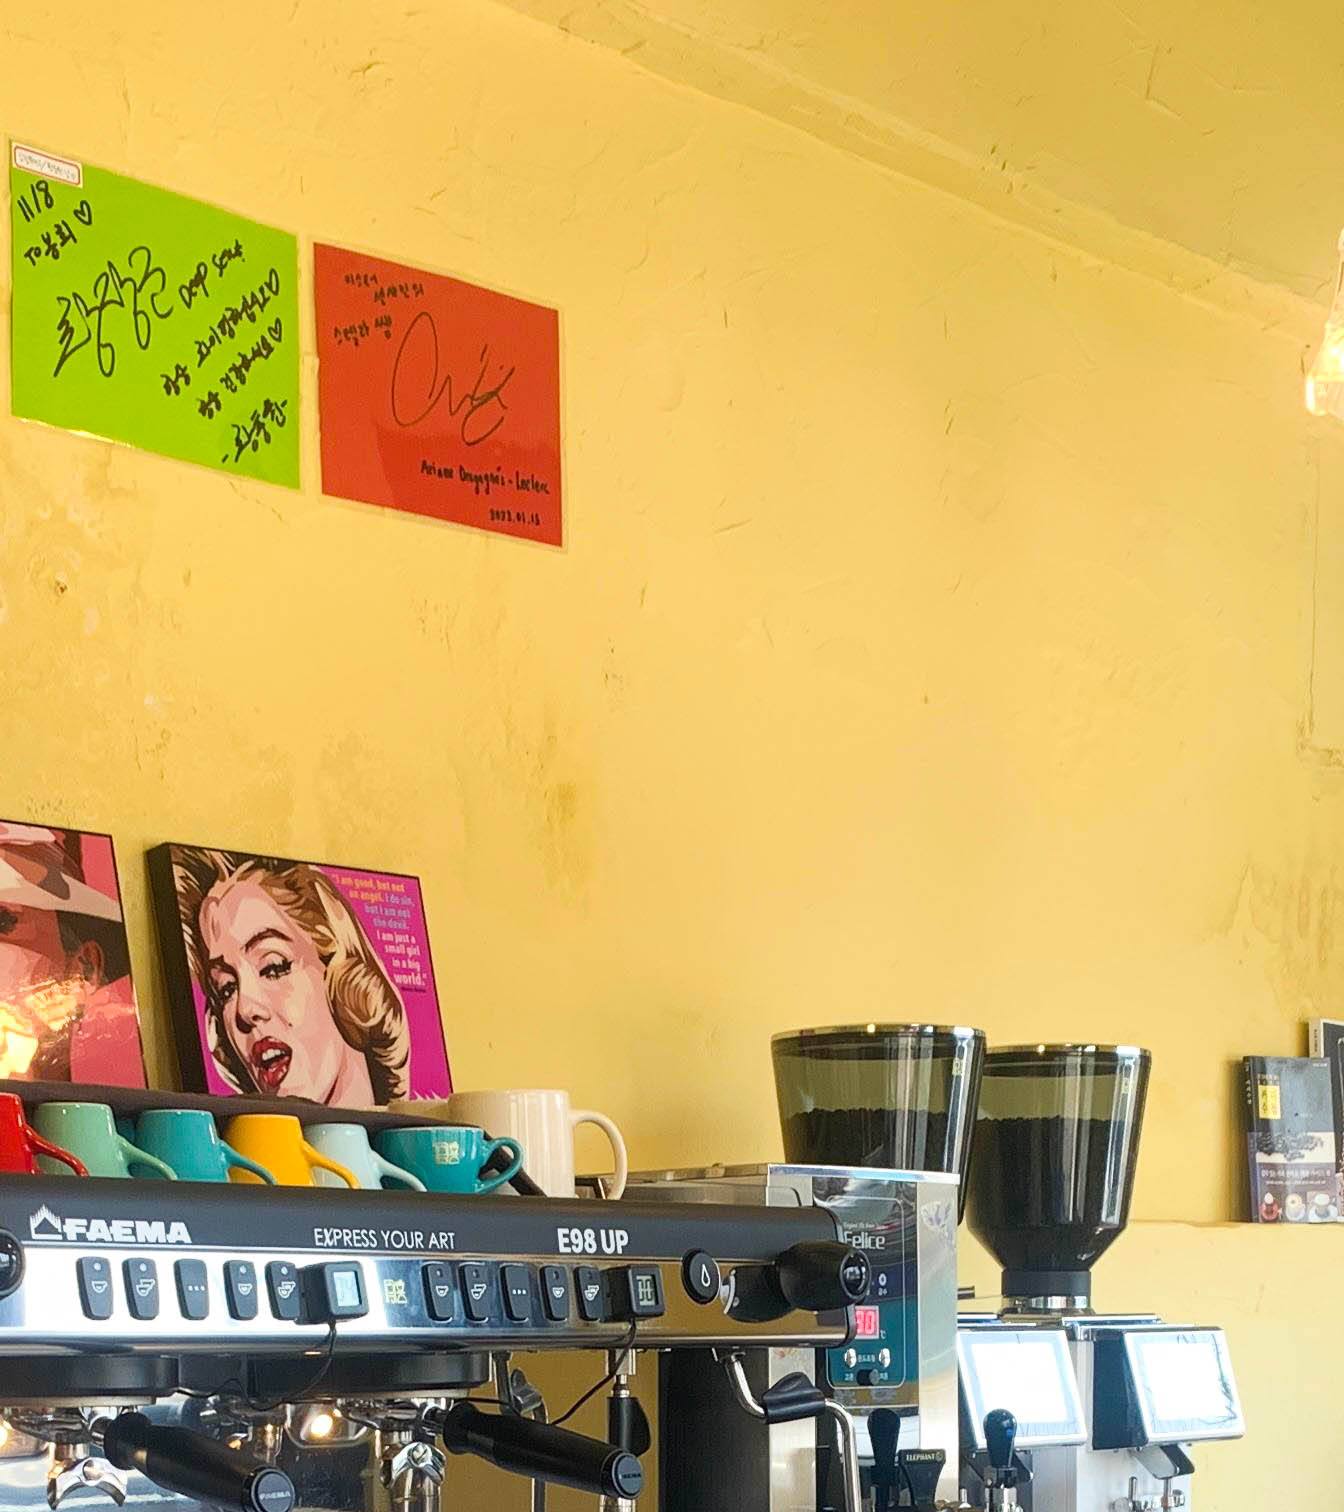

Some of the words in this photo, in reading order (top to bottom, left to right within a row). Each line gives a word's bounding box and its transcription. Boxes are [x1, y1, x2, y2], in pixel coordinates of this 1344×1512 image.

[62, 1217, 192, 1244] FAEMA
[314, 1228, 378, 1249] EXPRESS
[381, 1230, 425, 1250] YOUR
[428, 1231, 455, 1250] ART
[557, 1228, 598, 1254] E98
[600, 1229, 629, 1254] UP
[844, 1230, 886, 1250] Felice
[906, 1453, 935, 1461] ELEPHANT
